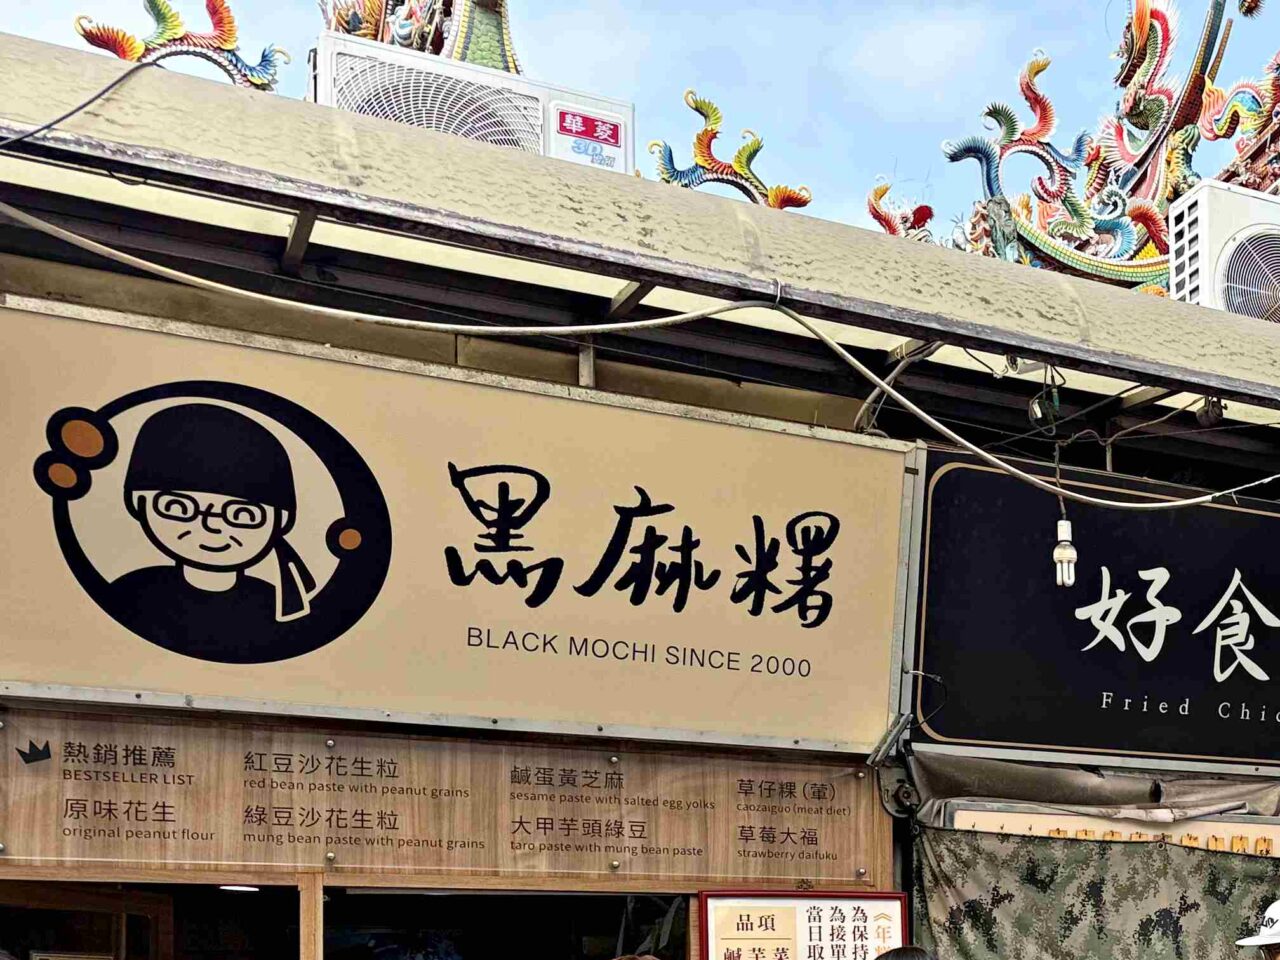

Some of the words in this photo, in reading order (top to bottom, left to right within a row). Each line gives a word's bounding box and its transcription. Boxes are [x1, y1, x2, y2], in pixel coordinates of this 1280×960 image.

[563, 113, 616, 143] 華菱
[444, 461, 841, 628] 黑麻糬
[466, 626, 559, 654] BLACK
[568, 636, 656, 663] MOCHI
[665, 645, 741, 671] SINCE
[750, 654, 812, 678] 2000
[1101, 692, 1190, 715] Fried
[63, 741, 176, 768] 熱銷推薦
[243, 751, 399, 779] 紅豆沙花生粒
[63, 769, 158, 784] BESTSELLER
[163, 774, 195, 786] LIST
[243, 778, 266, 789] red
[271, 779, 304, 791] bean
[308, 782, 345, 793] paste
[349, 783, 378, 795] with
[381, 786, 427, 797] peanut
[431, 787, 470, 799] grains
[510, 765, 624, 790] 鹹蛋黃芝麻
[63, 798, 176, 823] 原味花生
[510, 792, 555, 802] sesame
[559, 794, 591, 804] paste
[594, 795, 621, 805] with
[623, 796, 659, 807] salted
[662, 800, 683, 810] egg
[685, 798, 715, 810] yolks
[736, 803, 790, 815] caozaiguo
[243, 805, 399, 830] 綠豆沙花生粒
[511, 815, 647, 839] 大甲芋頭綠豆
[62, 827, 120, 840] original
[125, 829, 177, 844] peanut
[181, 828, 215, 841] flour
[243, 834, 283, 845] mung
[288, 832, 321, 844] bean
[325, 835, 361, 846] paste
[365, 836, 393, 847] with
[398, 838, 443, 849] peanut
[447, 838, 485, 850] grains
[737, 825, 818, 846] 草莓大福
[510, 841, 535, 850] taro
[539, 842, 571, 853] paste
[575, 843, 600, 853] with
[604, 845, 637, 856] mung
[641, 844, 669, 855] bean
[673, 846, 703, 857] paste
[737, 849, 795, 861] strawberry
[799, 850, 837, 861] daifuku
[736, 914, 776, 932] 品項
